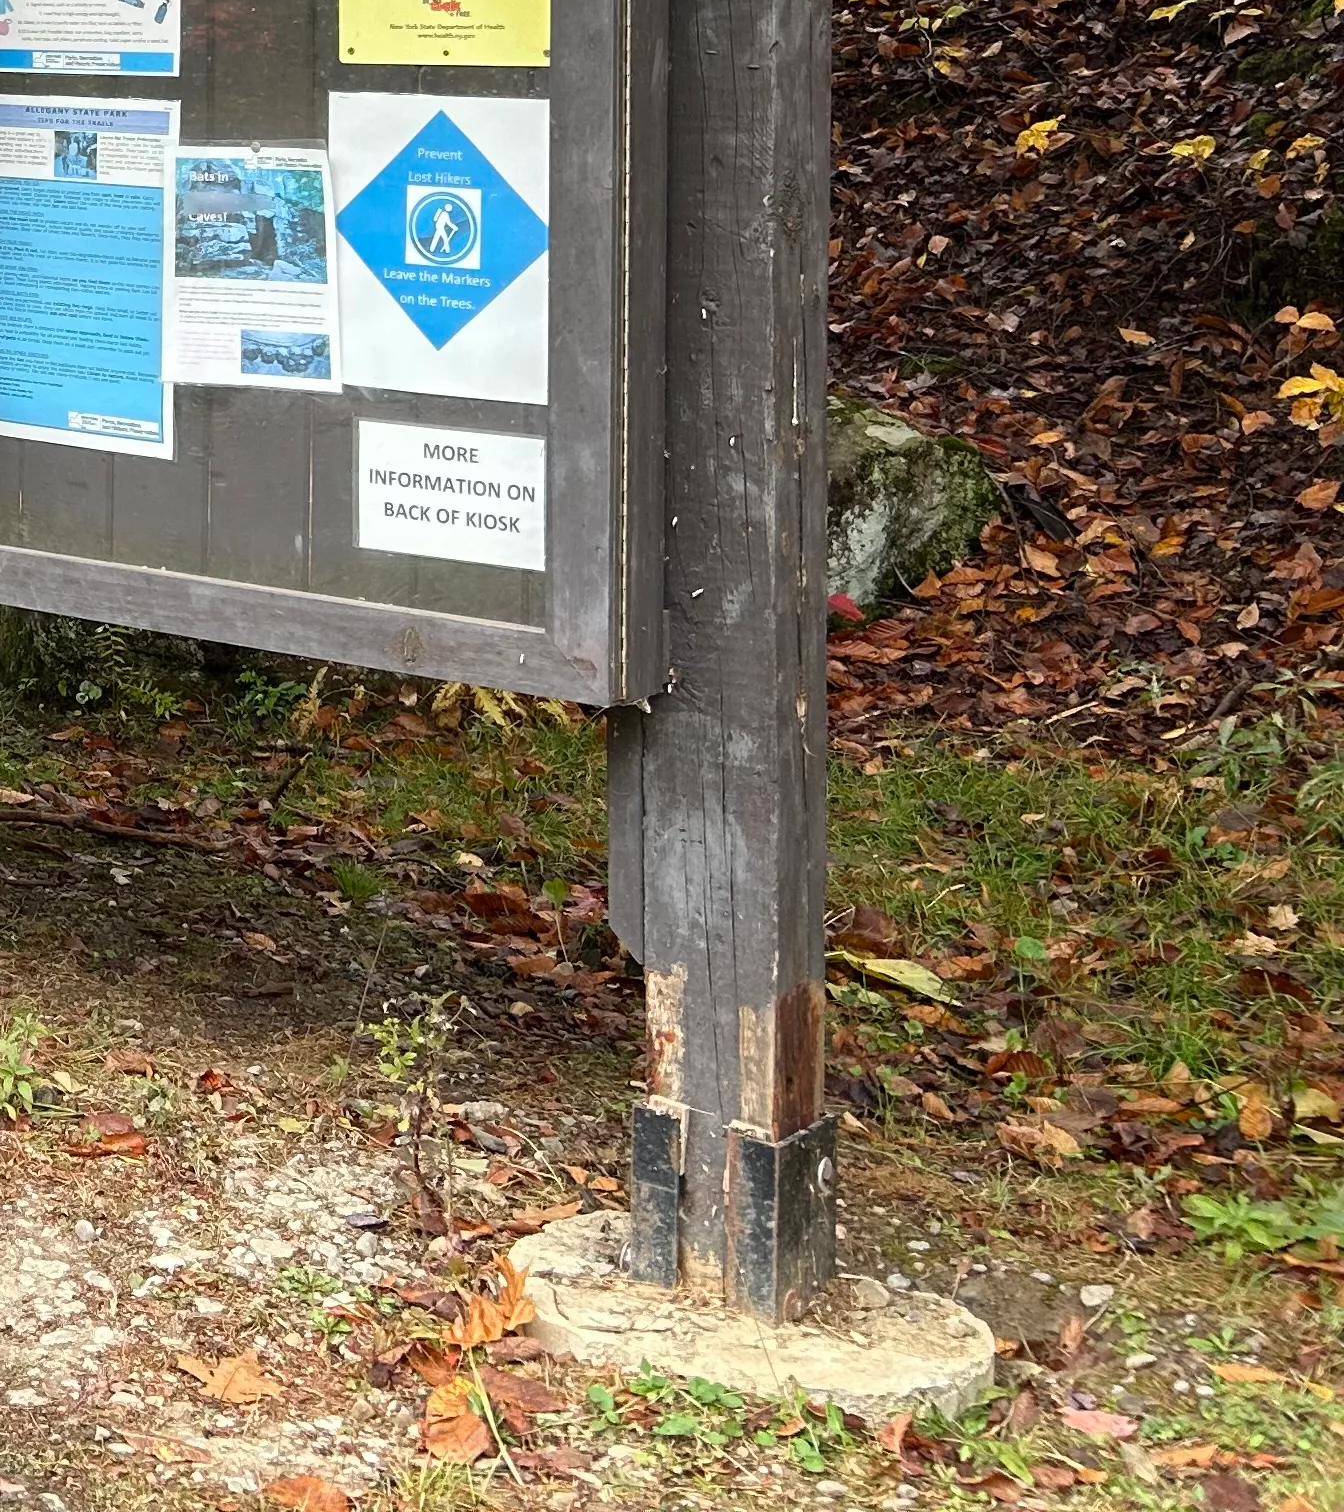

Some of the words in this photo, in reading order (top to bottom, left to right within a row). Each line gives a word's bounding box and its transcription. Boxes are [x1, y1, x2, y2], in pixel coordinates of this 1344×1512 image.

[73, 108, 100, 116] STATE
[417, 148, 463, 162] Prevent
[189, 171, 214, 182] Bats
[408, 172, 432, 184] Lost
[435, 172, 471, 186] Hikers
[383, 268, 416, 282] Leave
[418, 271, 439, 283] the
[441, 272, 491, 288] Markers
[400, 294, 415, 304] on
[418, 295, 438, 306] the
[440, 296, 475, 310] Trees.
[423, 443, 479, 463] MORE
[369, 468, 500, 498] INFORMATION
[507, 485, 535, 503] ON
[384, 502, 431, 522] BACK
[436, 508, 460, 525] OF
[466, 511, 521, 533] KIOSK
